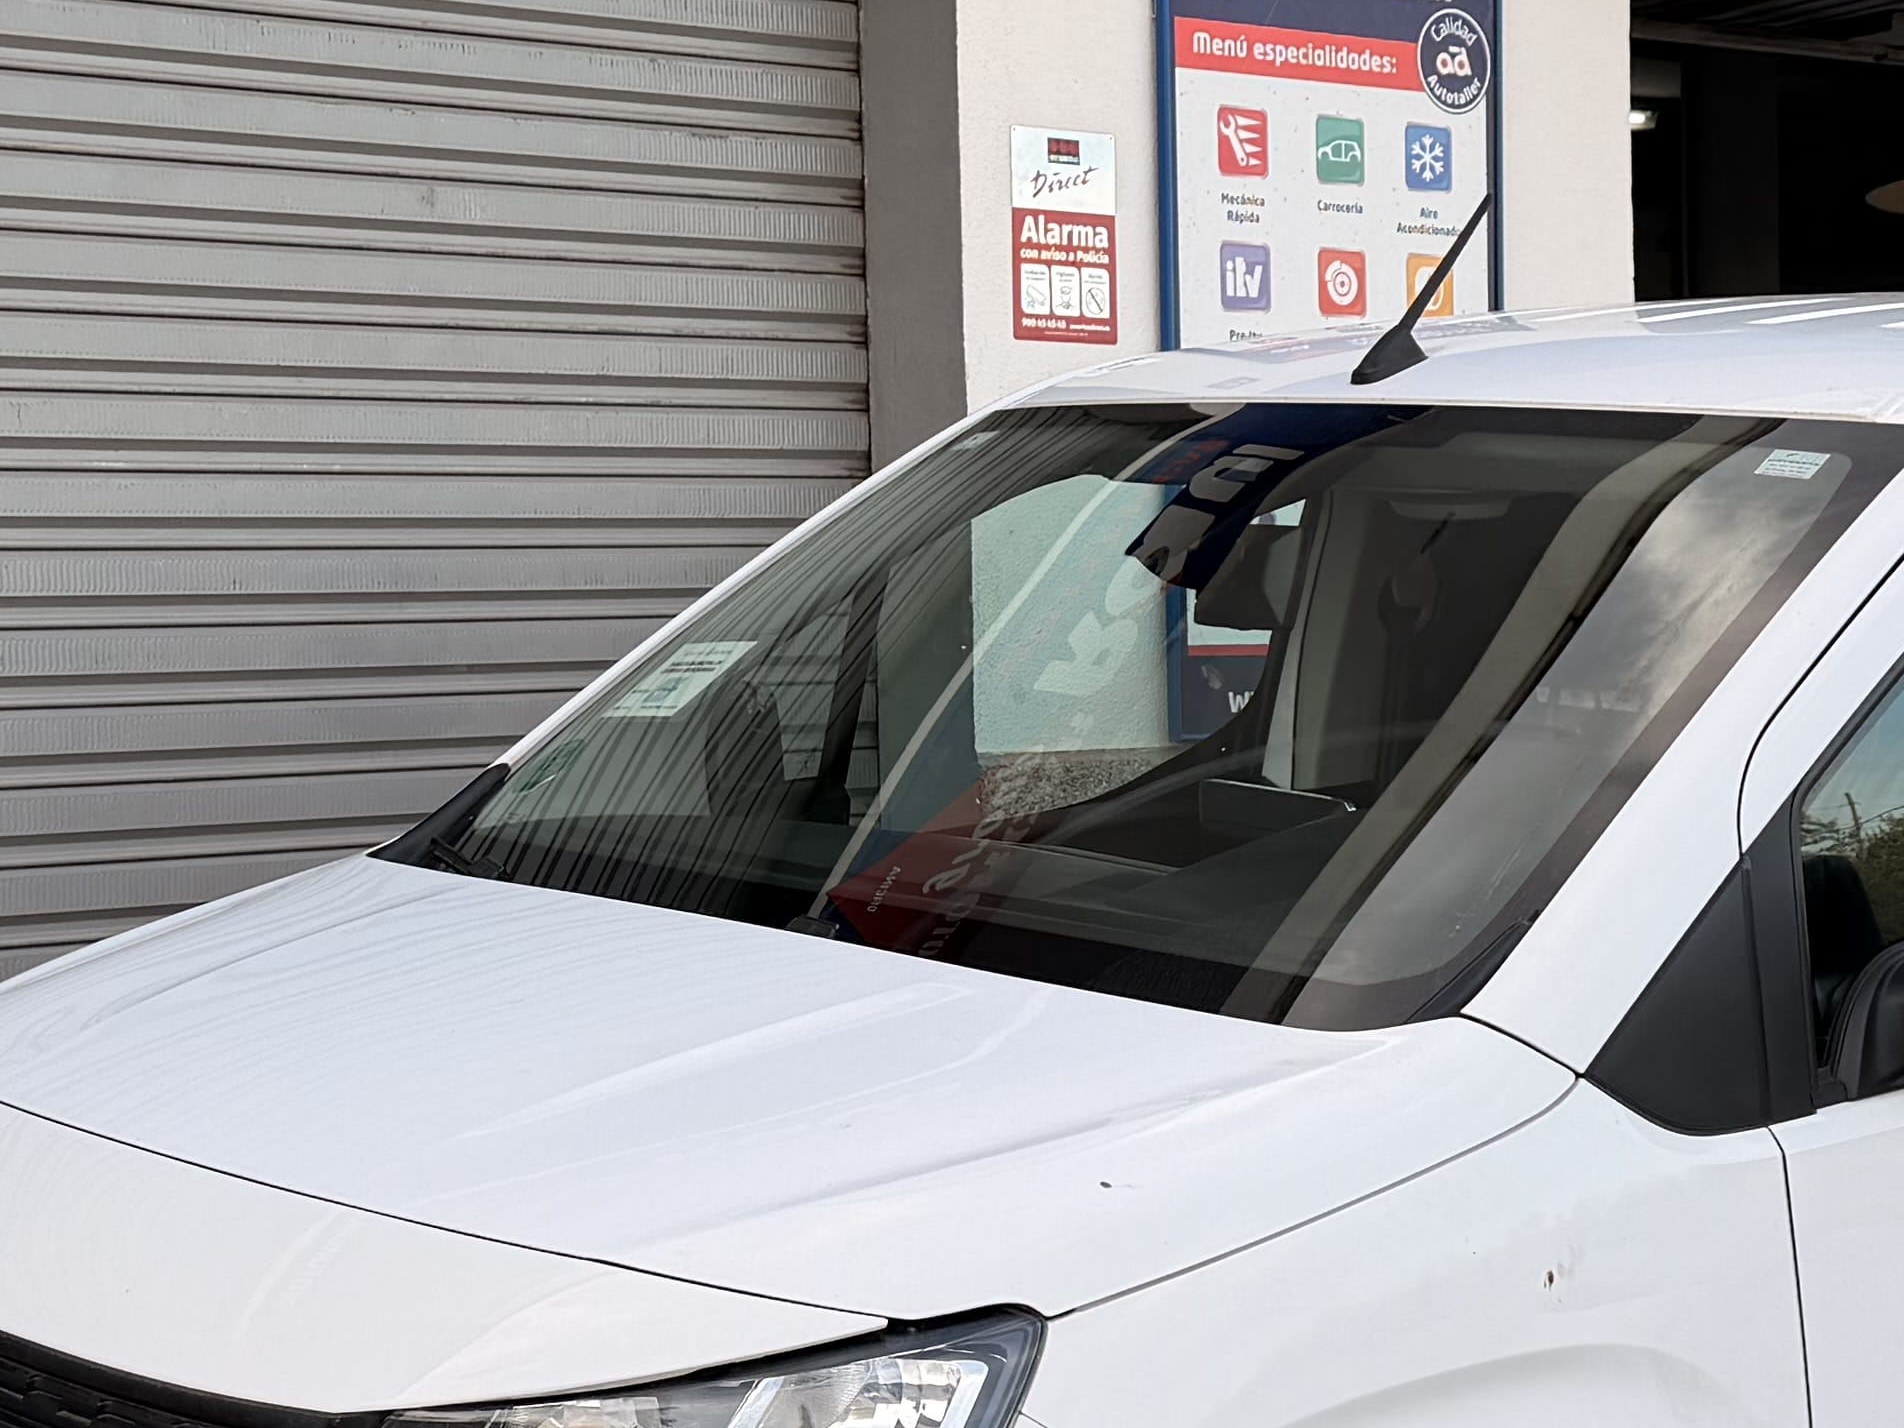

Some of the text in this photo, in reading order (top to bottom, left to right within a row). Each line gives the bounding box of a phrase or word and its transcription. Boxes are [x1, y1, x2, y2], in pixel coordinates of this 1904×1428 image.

[1430, 15, 1478, 46] Calidad
[1192, 30, 1398, 75] Menú especialidades:
[1427, 74, 1481, 105] Autotaller
[1030, 166, 1100, 198] Direct
[1220, 192, 1265, 208] Mecánica
[1317, 199, 1363, 215] Carrocería
[1227, 210, 1260, 224] Rápida
[1420, 207, 1438, 219] Aire
[1020, 214, 1108, 249] Alarma
[1020, 248, 1038, 260] con
